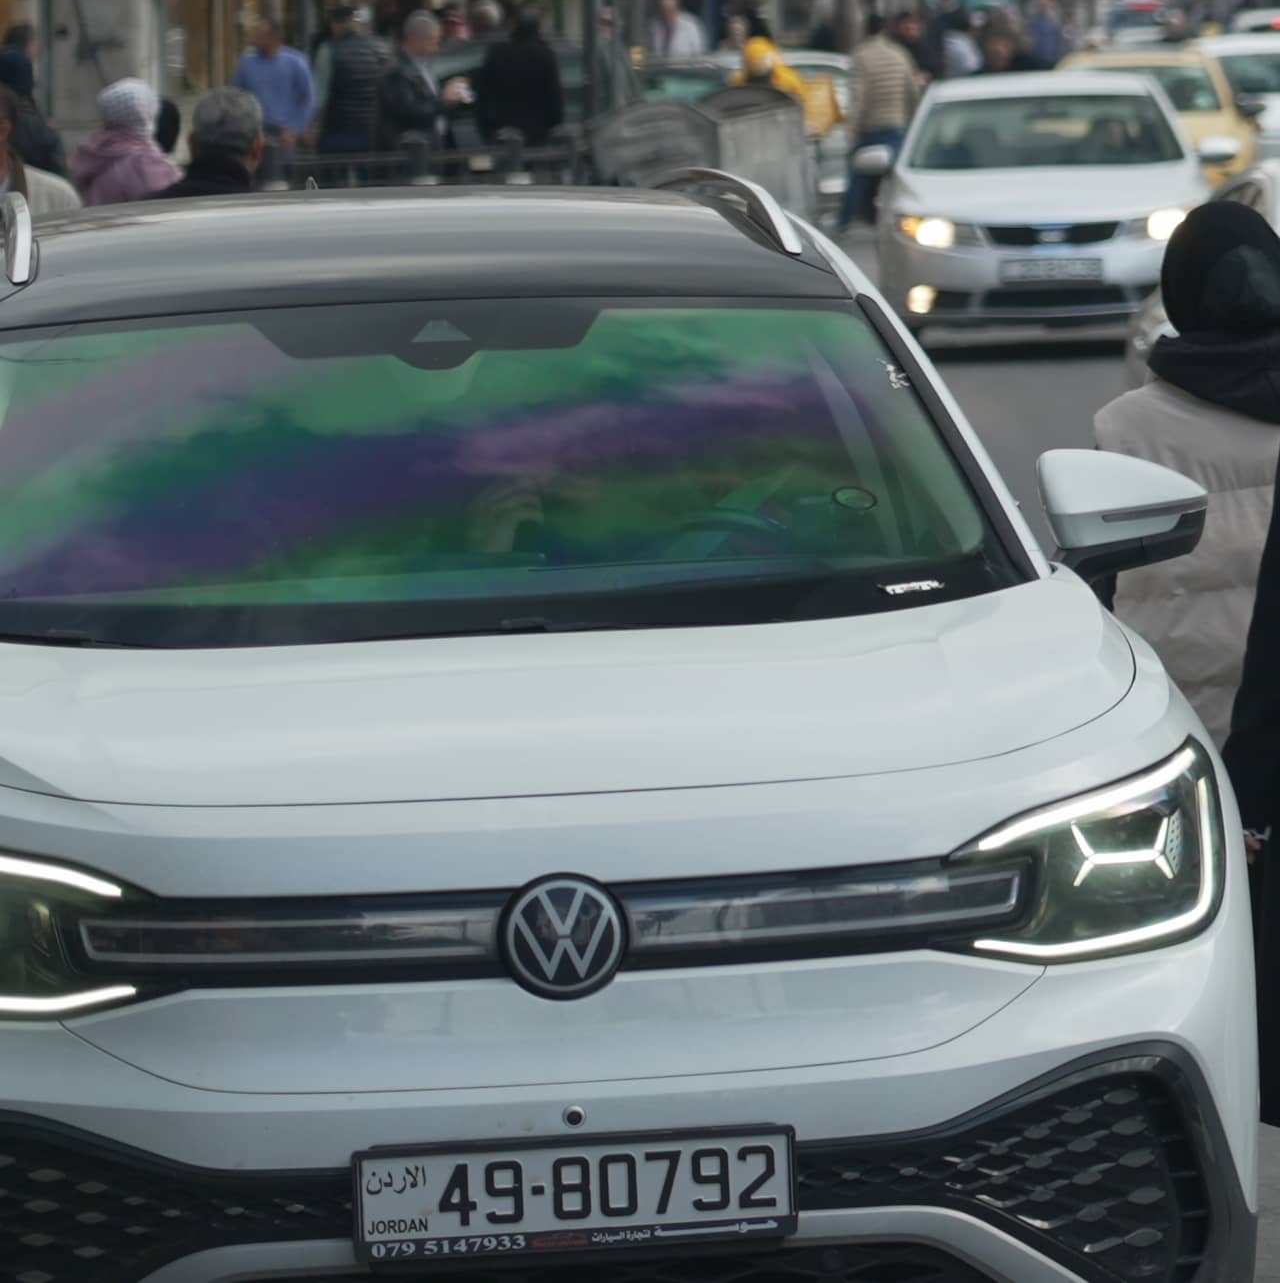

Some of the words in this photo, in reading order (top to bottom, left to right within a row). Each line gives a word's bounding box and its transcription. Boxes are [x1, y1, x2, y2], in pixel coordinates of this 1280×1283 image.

[438, 1144, 778, 1227] 49-80792
[367, 1217, 429, 1236] JORDAN
[371, 1241, 416, 1259] 079
[423, 1234, 527, 1256] 5147933
